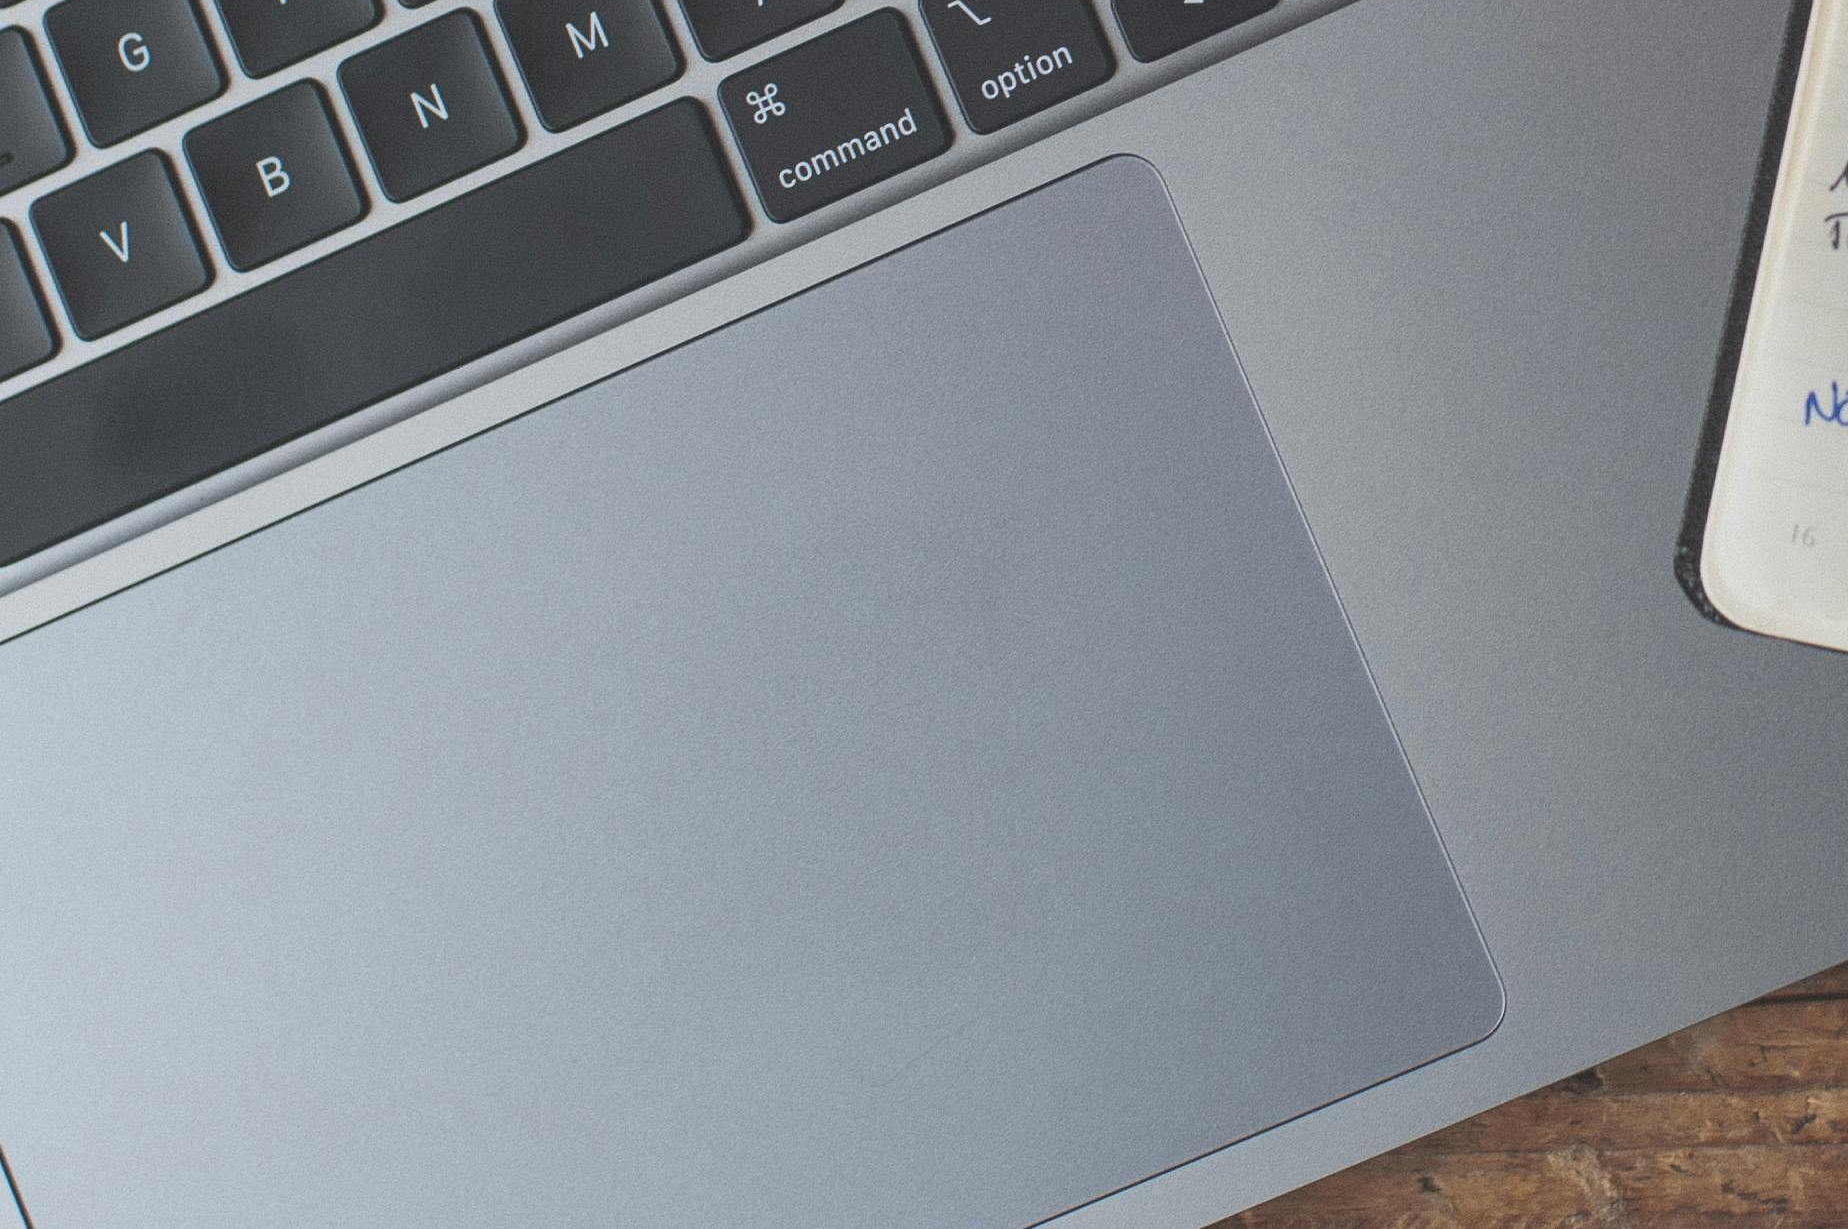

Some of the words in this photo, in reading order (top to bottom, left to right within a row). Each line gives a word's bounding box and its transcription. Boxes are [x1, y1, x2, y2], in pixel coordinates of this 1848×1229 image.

[117, 31, 151, 73] G
[564, 10, 610, 60] M
[980, 43, 1073, 101] option
[409, 82, 450, 130] N
[778, 107, 918, 190] command
[255, 155, 291, 198] B
[98, 220, 130, 264] V
[1790, 522, 1816, 549] 16
